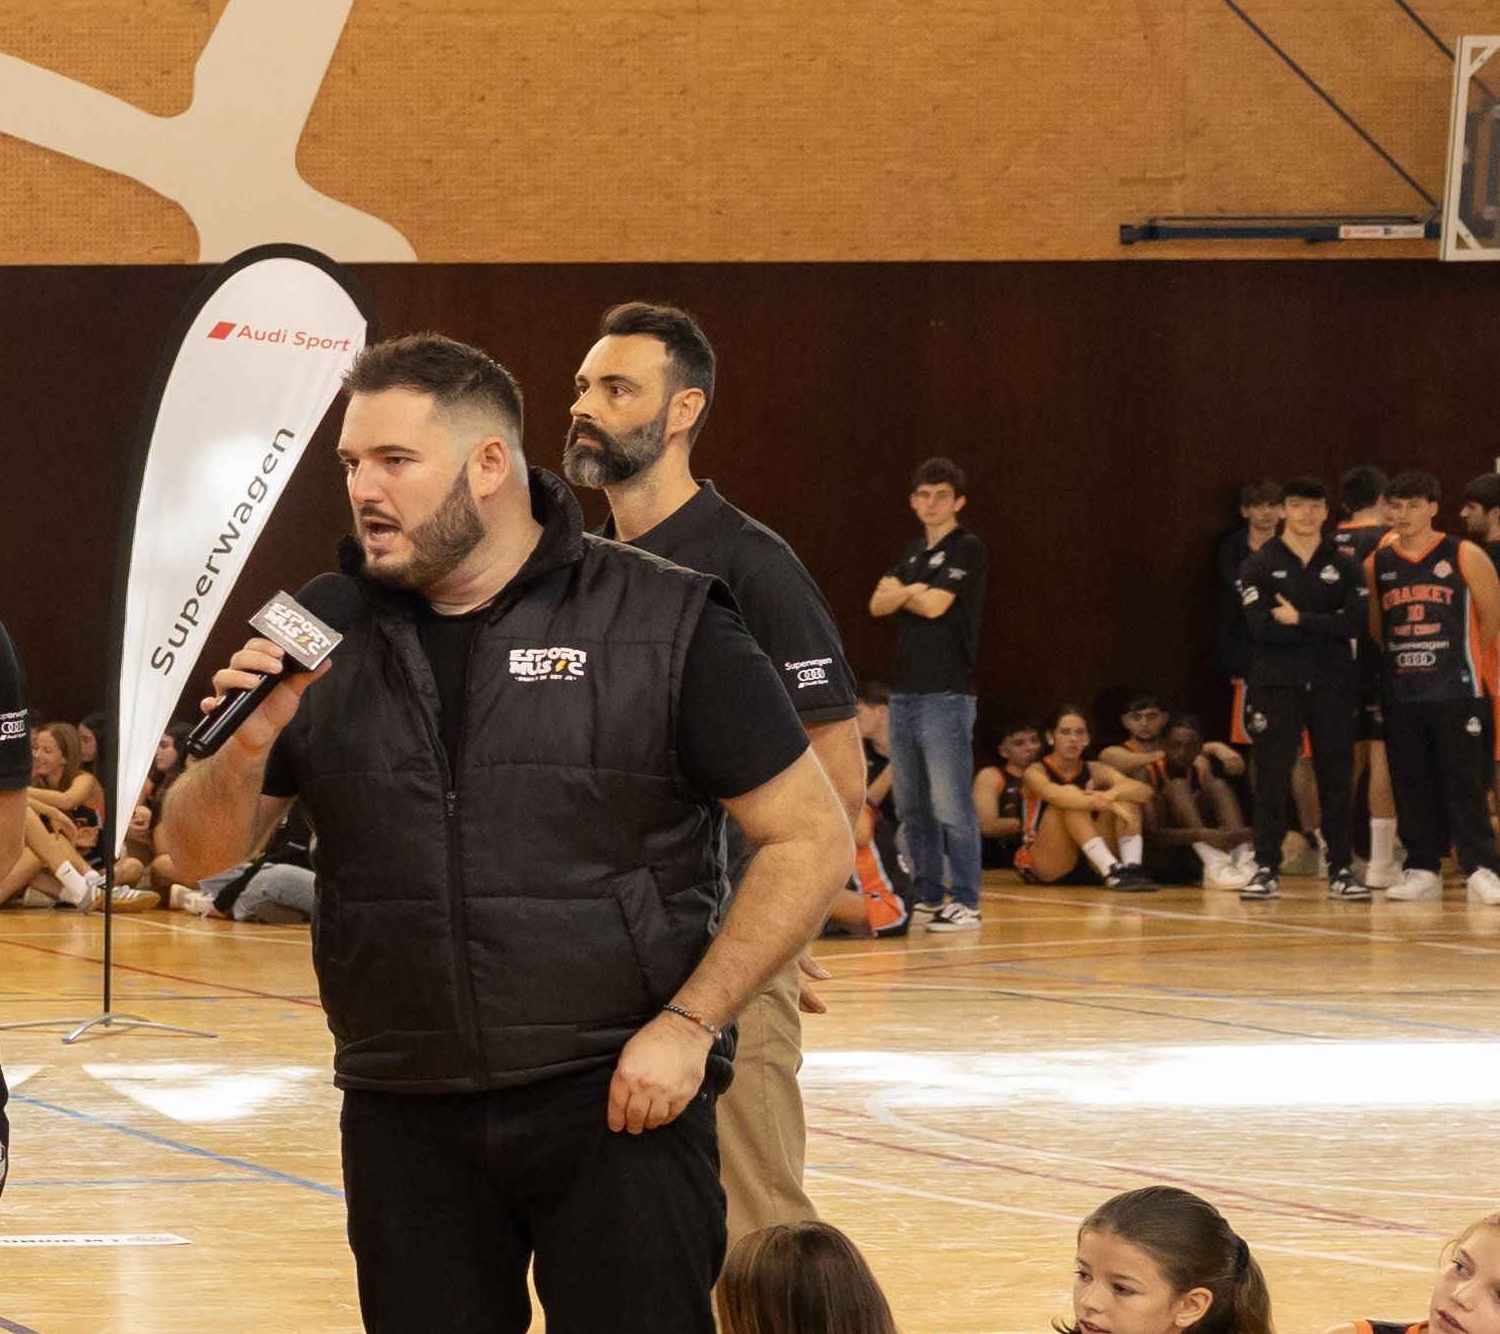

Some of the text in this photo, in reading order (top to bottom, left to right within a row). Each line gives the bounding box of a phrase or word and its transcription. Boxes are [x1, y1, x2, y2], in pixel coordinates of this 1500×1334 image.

[236, 325, 351, 352] Audi Sport
[151, 426, 297, 676] Superwagen
[270, 602, 332, 648] ESPORT
[509, 647, 588, 663] ESPORT
